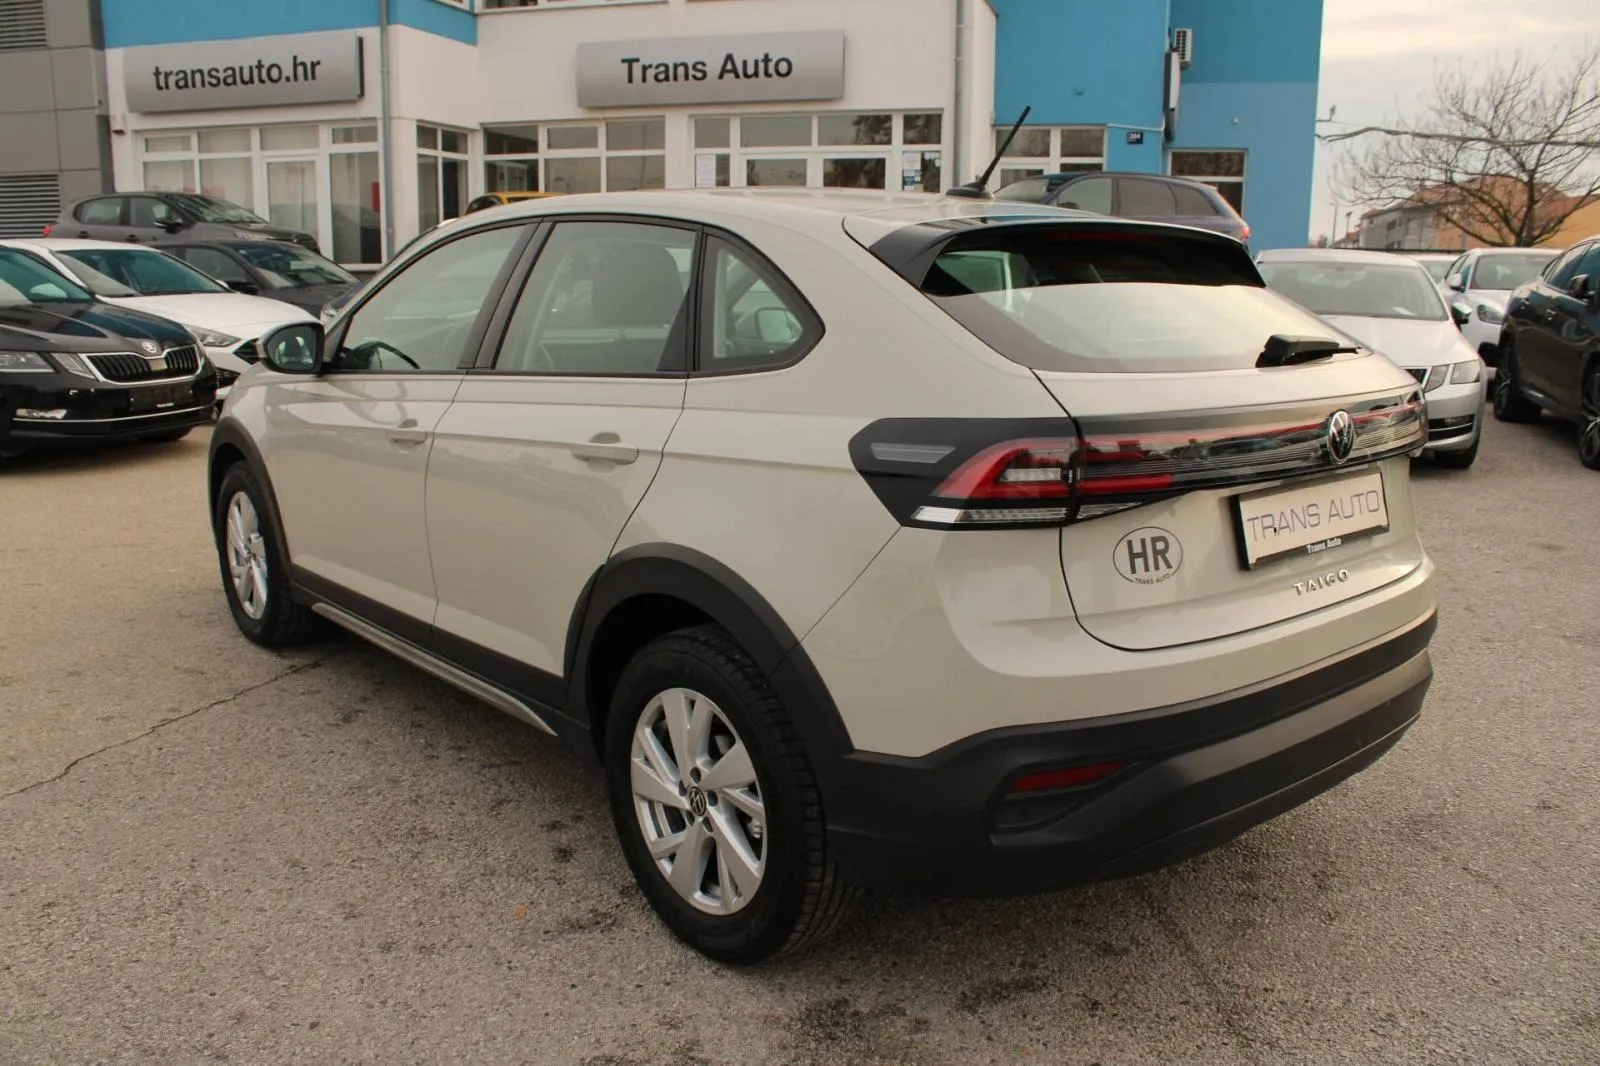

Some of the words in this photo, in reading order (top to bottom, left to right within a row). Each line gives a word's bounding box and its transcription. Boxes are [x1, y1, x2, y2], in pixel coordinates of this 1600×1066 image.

[153, 55, 321, 91] transauto.hr
[621, 57, 708, 84] Trans
[717, 52, 793, 80] Auto
[1246, 503, 1321, 543] TRANS
[1327, 489, 1381, 523] AUTO
[1126, 535, 1173, 575] HR
[1306, 542, 1326, 554] Trans
[1326, 537, 1342, 549] Auto
[1134, 577, 1155, 585] TRANS
[1292, 569, 1350, 596] TAIGO
